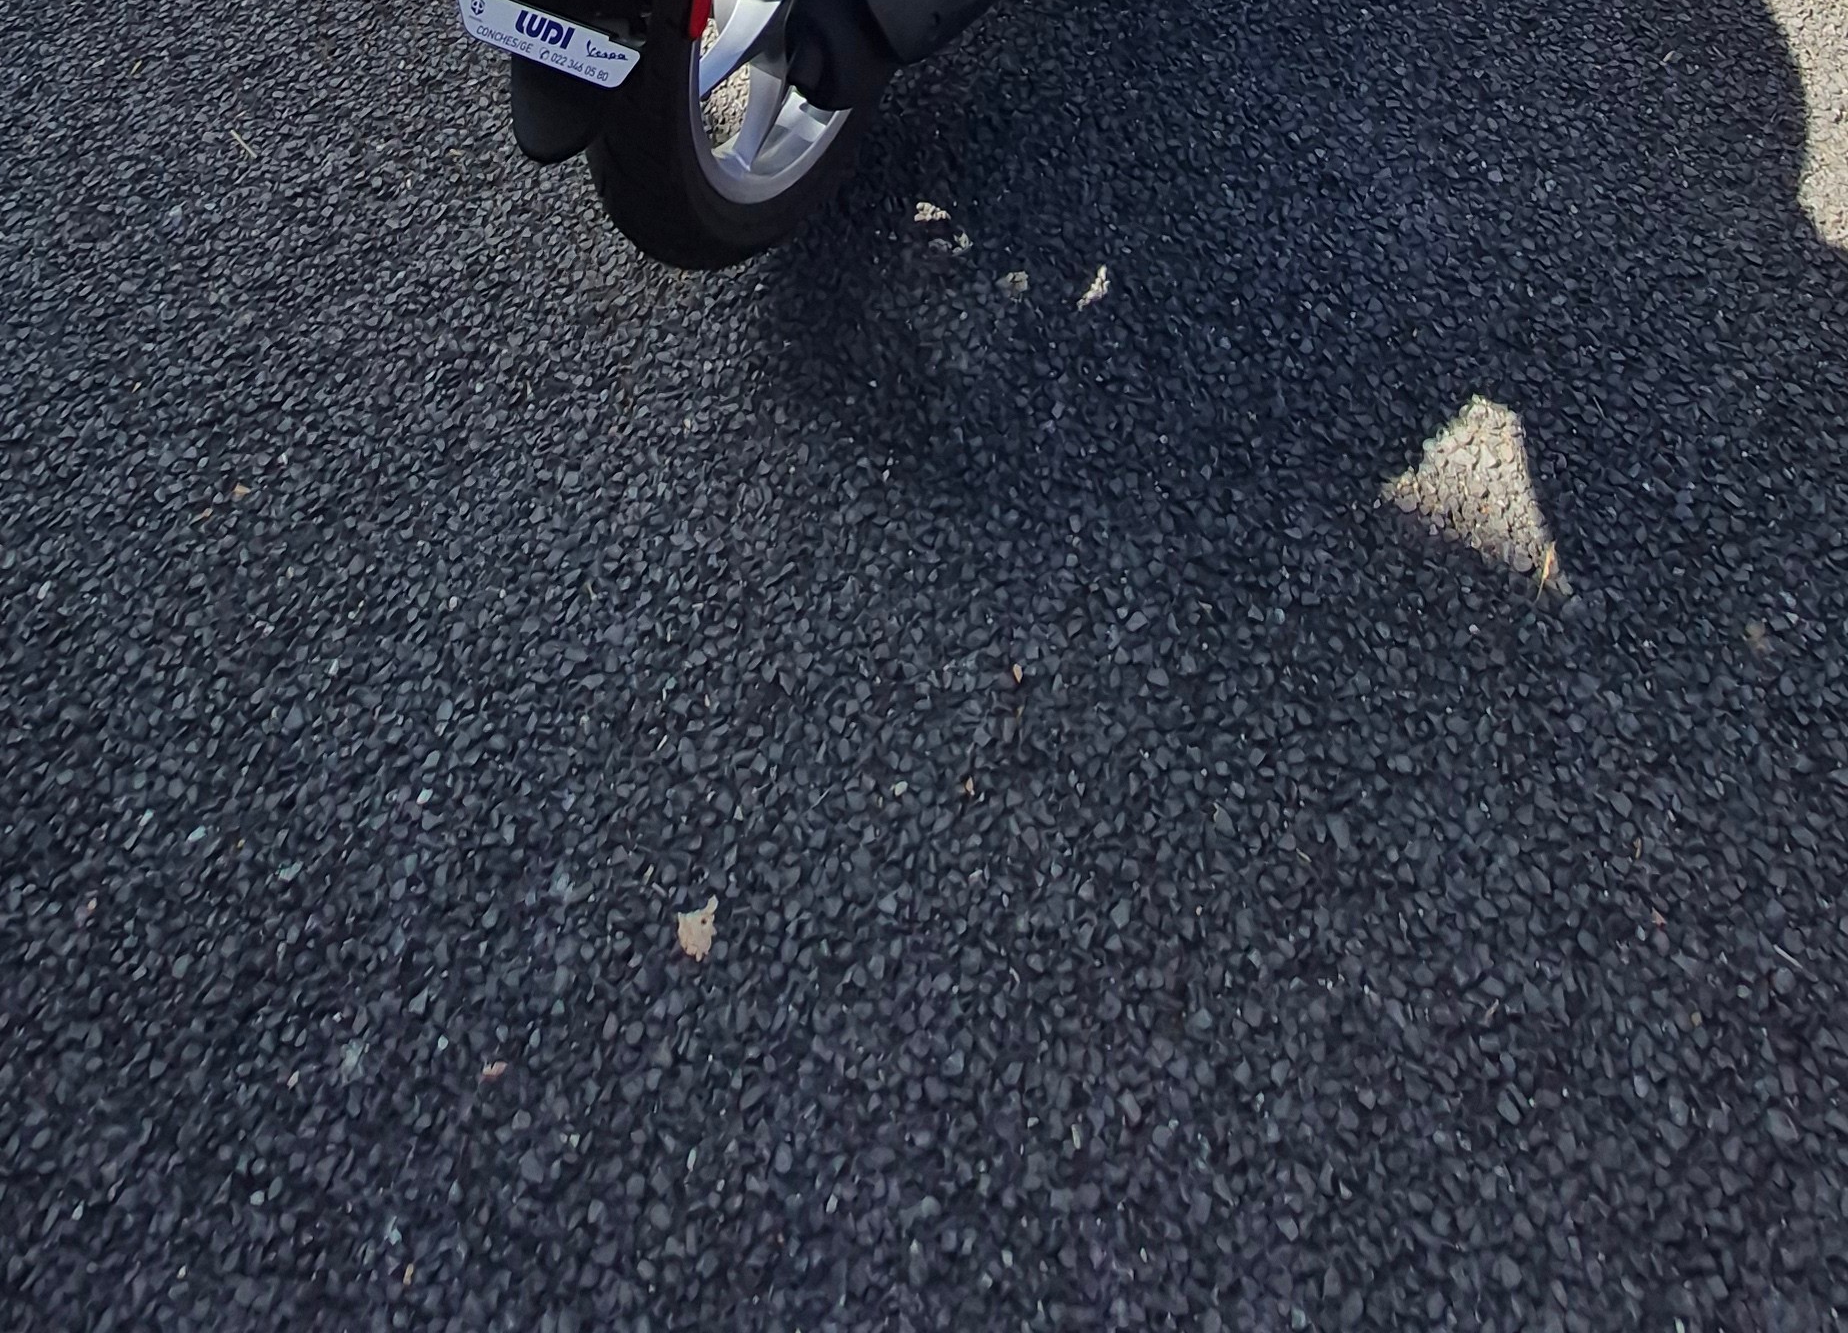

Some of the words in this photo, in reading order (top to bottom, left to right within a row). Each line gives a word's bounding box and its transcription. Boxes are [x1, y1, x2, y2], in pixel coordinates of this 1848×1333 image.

[514, 9, 576, 50] LUDI
[586, 39, 629, 61] Vespa
[476, 25, 534, 53] CONCHES/GE
[550, 52, 568, 67] 022
[567, 58, 584, 73] 346
[584, 65, 596, 78] 05
[596, 69, 609, 82] 80
